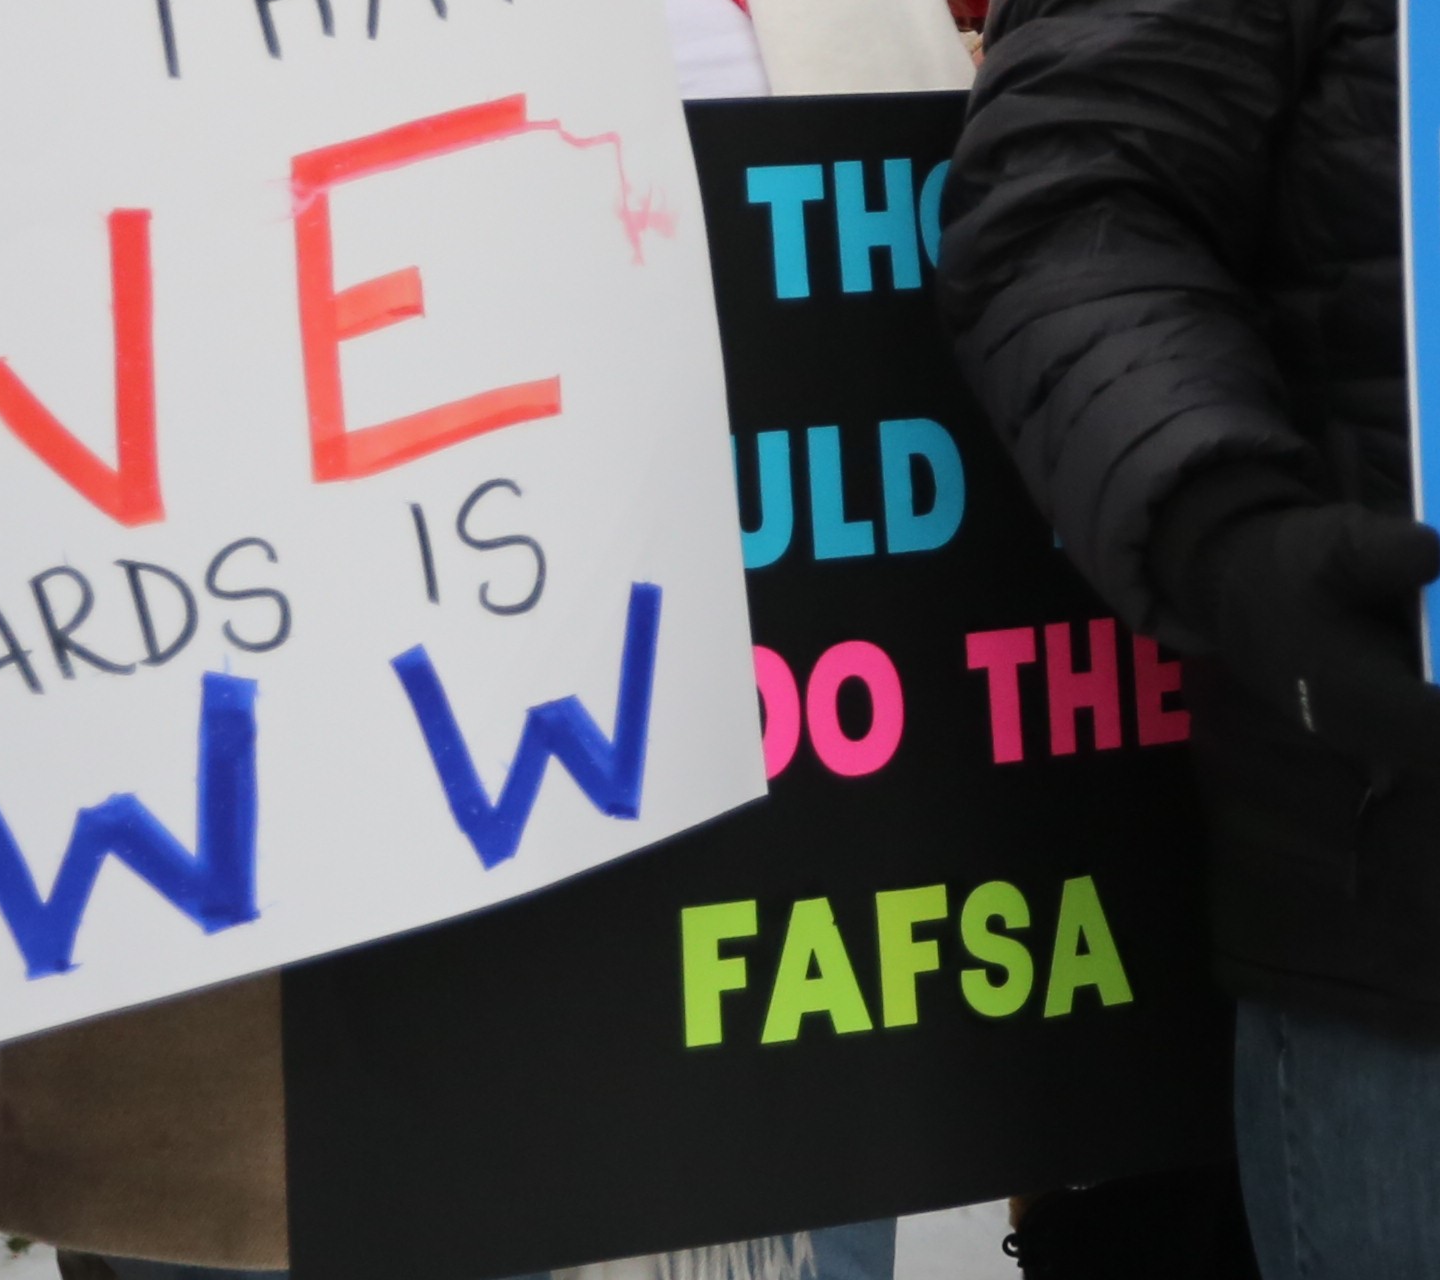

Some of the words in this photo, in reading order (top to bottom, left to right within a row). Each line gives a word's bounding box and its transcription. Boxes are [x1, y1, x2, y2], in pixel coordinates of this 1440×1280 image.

[407, 477, 549, 618] IS
[730, 418, 966, 570] ULD
[966, 616, 1195, 767] THE
[680, 873, 1134, 1049] FAFSA
